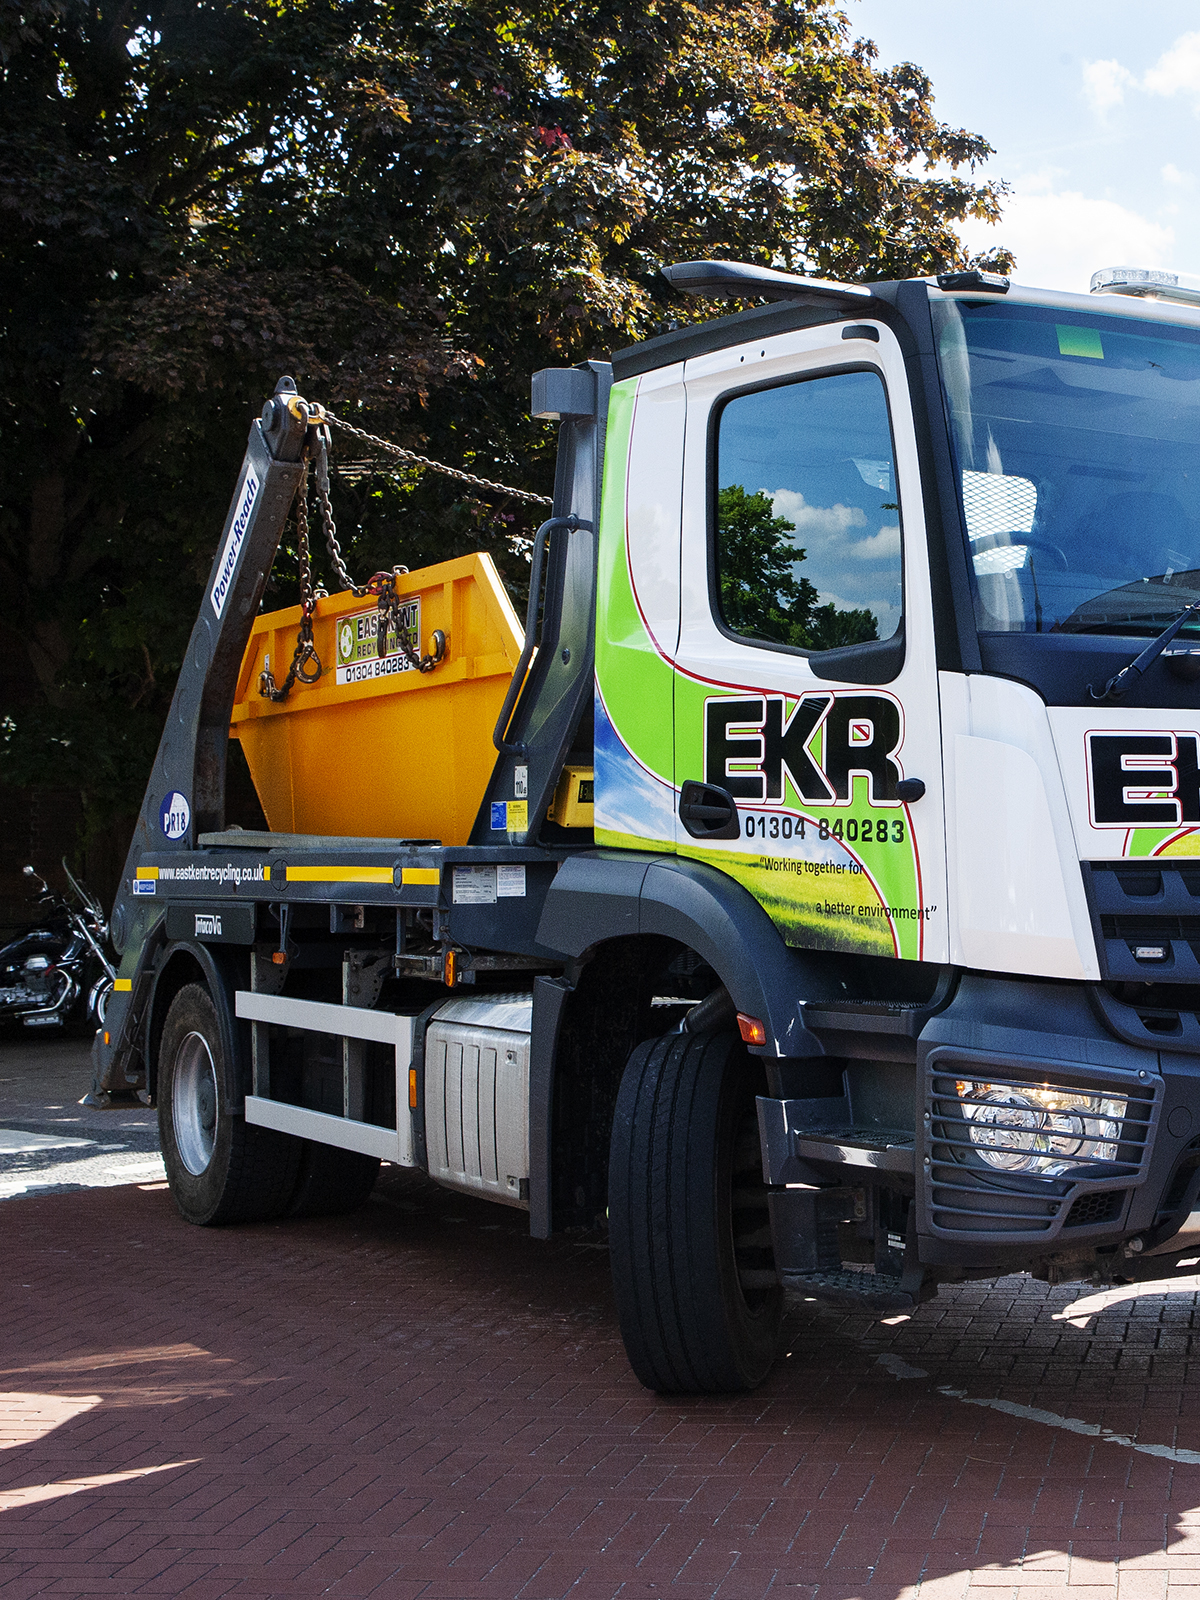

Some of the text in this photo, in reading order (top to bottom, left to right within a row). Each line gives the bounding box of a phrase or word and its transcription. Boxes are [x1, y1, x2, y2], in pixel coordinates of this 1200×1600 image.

[213, 478, 257, 610] Power-Reach
[357, 611, 382, 641] EAS
[357, 636, 401, 658] RECYING
[345, 656, 409, 682] 01304 840283
[705, 692, 903, 805] EKR
[164, 812, 185, 833] PR18
[745, 816, 905, 843] 01304 840283
[158, 863, 264, 885] www.eastkentrecycling.co.uk
[804, 861, 846, 877] together
[849, 860, 864, 875] for
[816, 902, 822, 913] a
[824, 900, 855, 916] better
